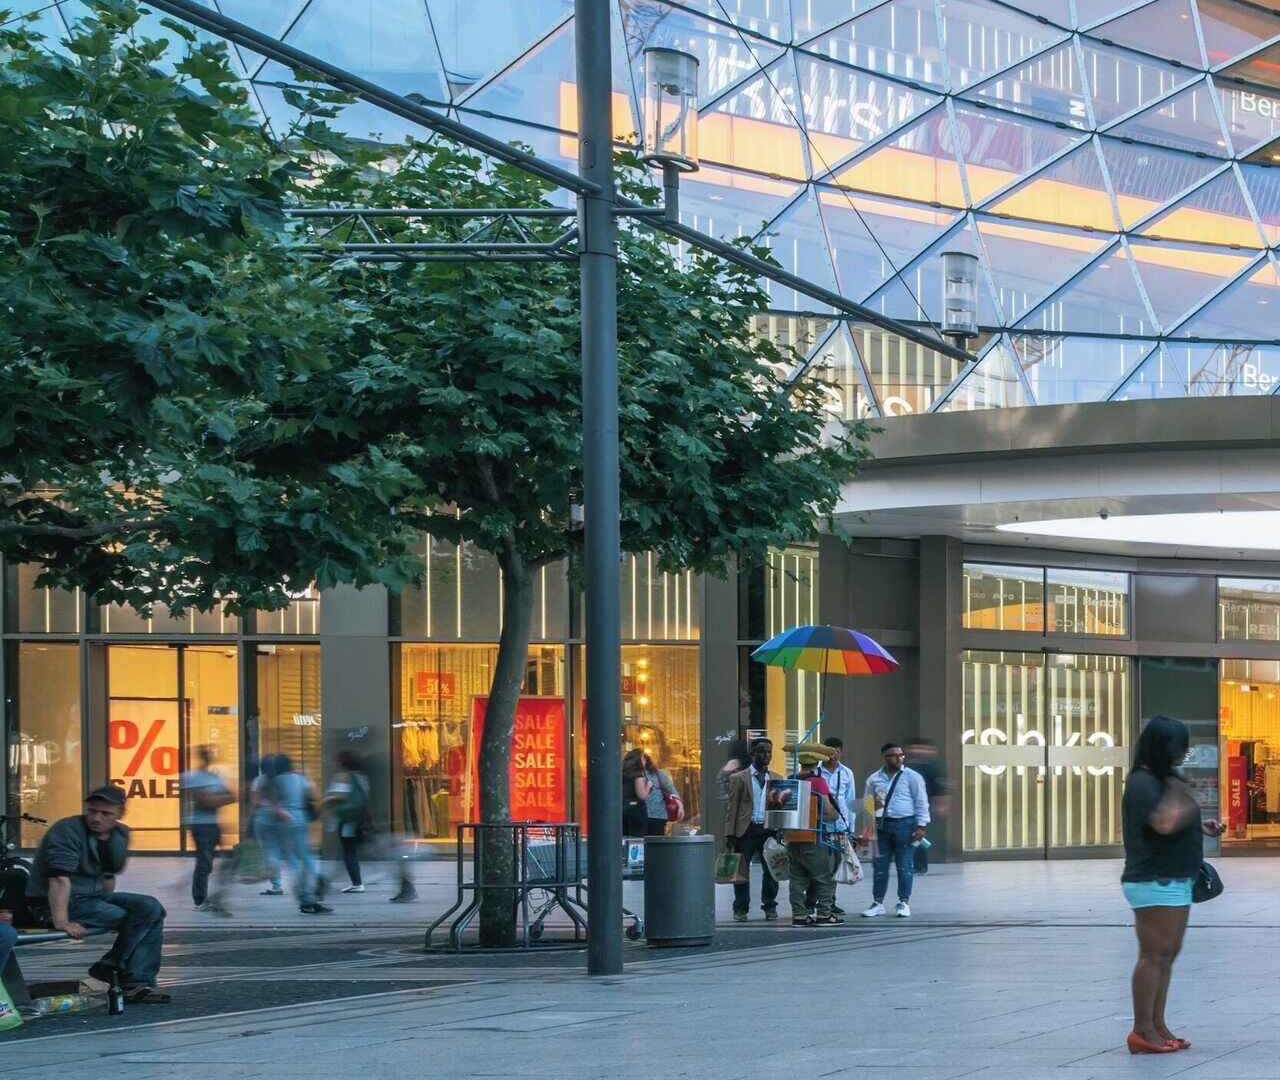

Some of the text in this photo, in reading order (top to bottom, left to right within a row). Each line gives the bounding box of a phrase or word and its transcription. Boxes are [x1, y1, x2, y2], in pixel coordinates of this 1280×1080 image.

[514, 714, 557, 730] SALE
[514, 733, 557, 750] SALE
[514, 752, 557, 769] SALE
[514, 772, 557, 789] SALE
[514, 791, 557, 808] SALE
[1232, 779, 1241, 808] SALE
